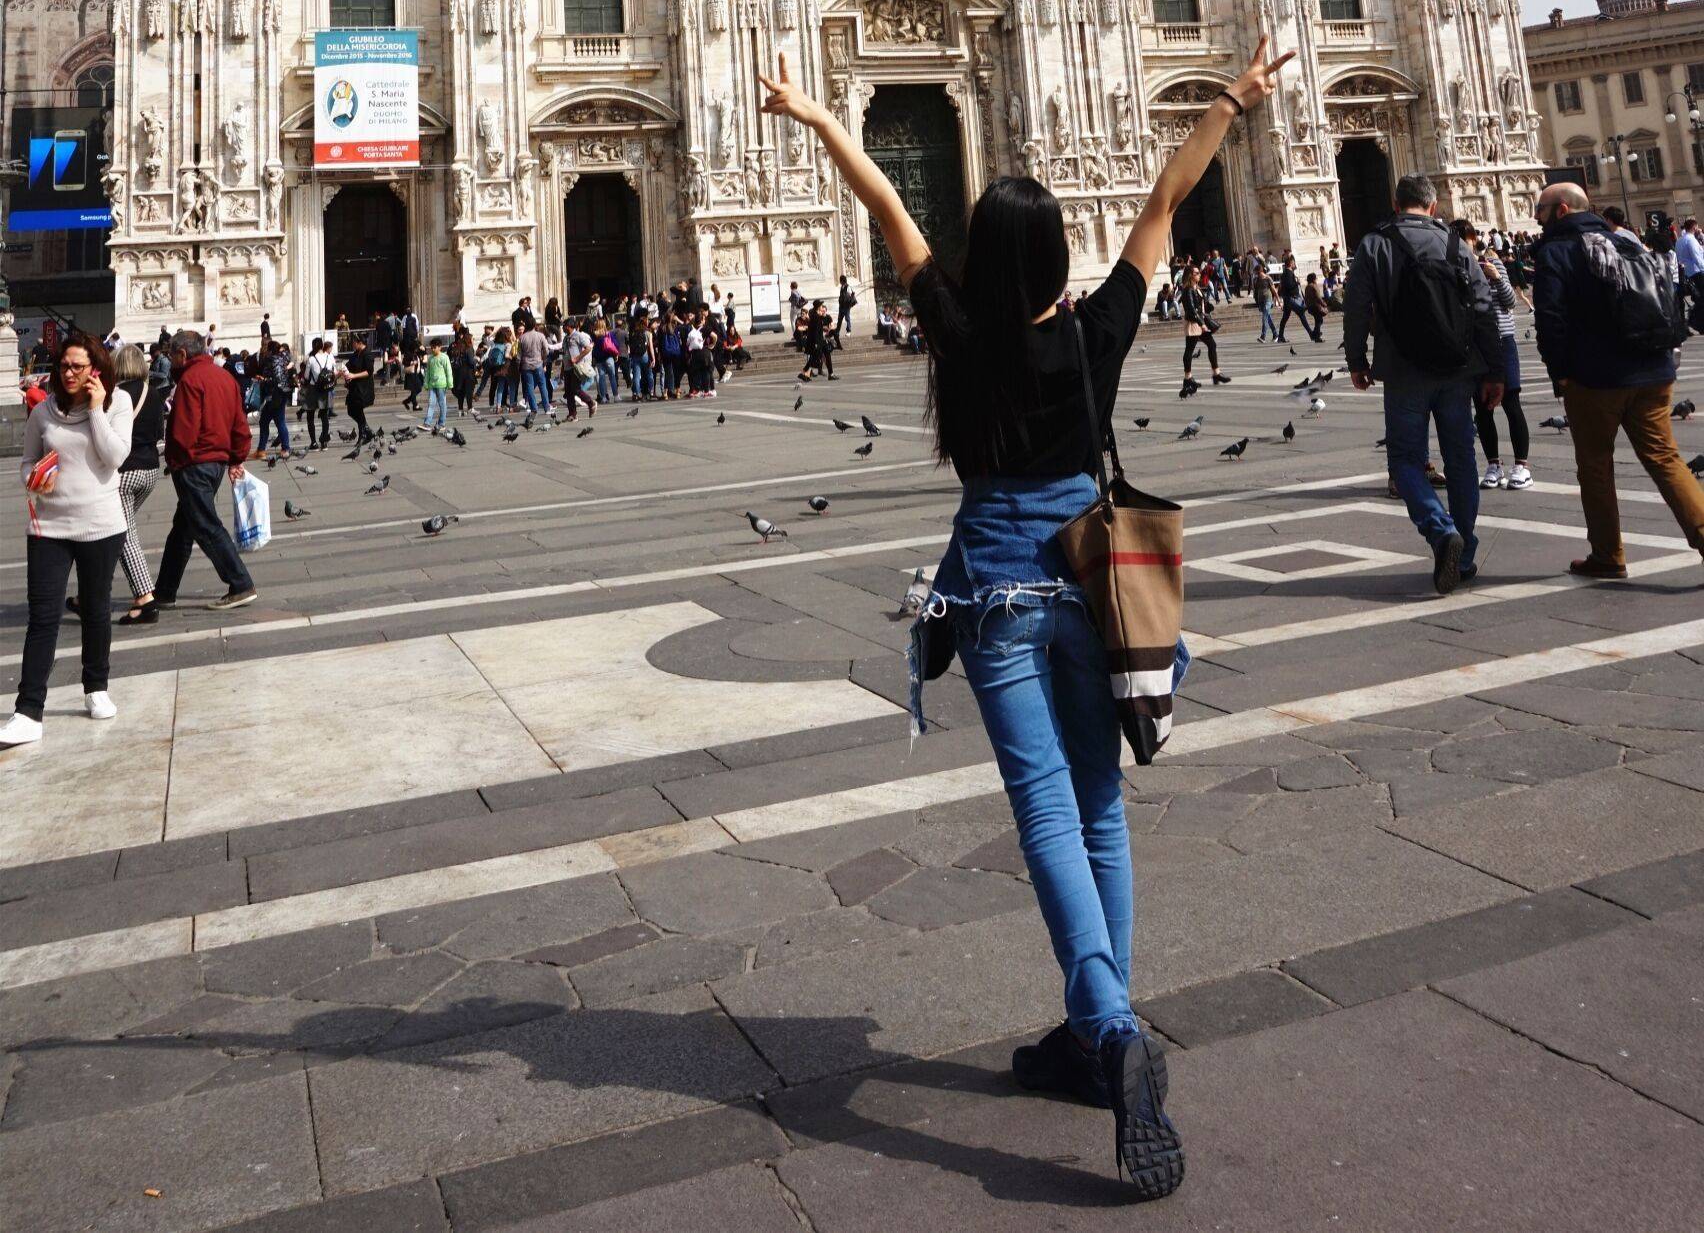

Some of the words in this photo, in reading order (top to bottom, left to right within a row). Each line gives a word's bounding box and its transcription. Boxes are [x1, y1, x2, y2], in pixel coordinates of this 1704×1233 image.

[351, 43, 407, 51] MISERICORDIA
[366, 80, 409, 88] Cattedrale
[381, 90, 404, 98] Maria
